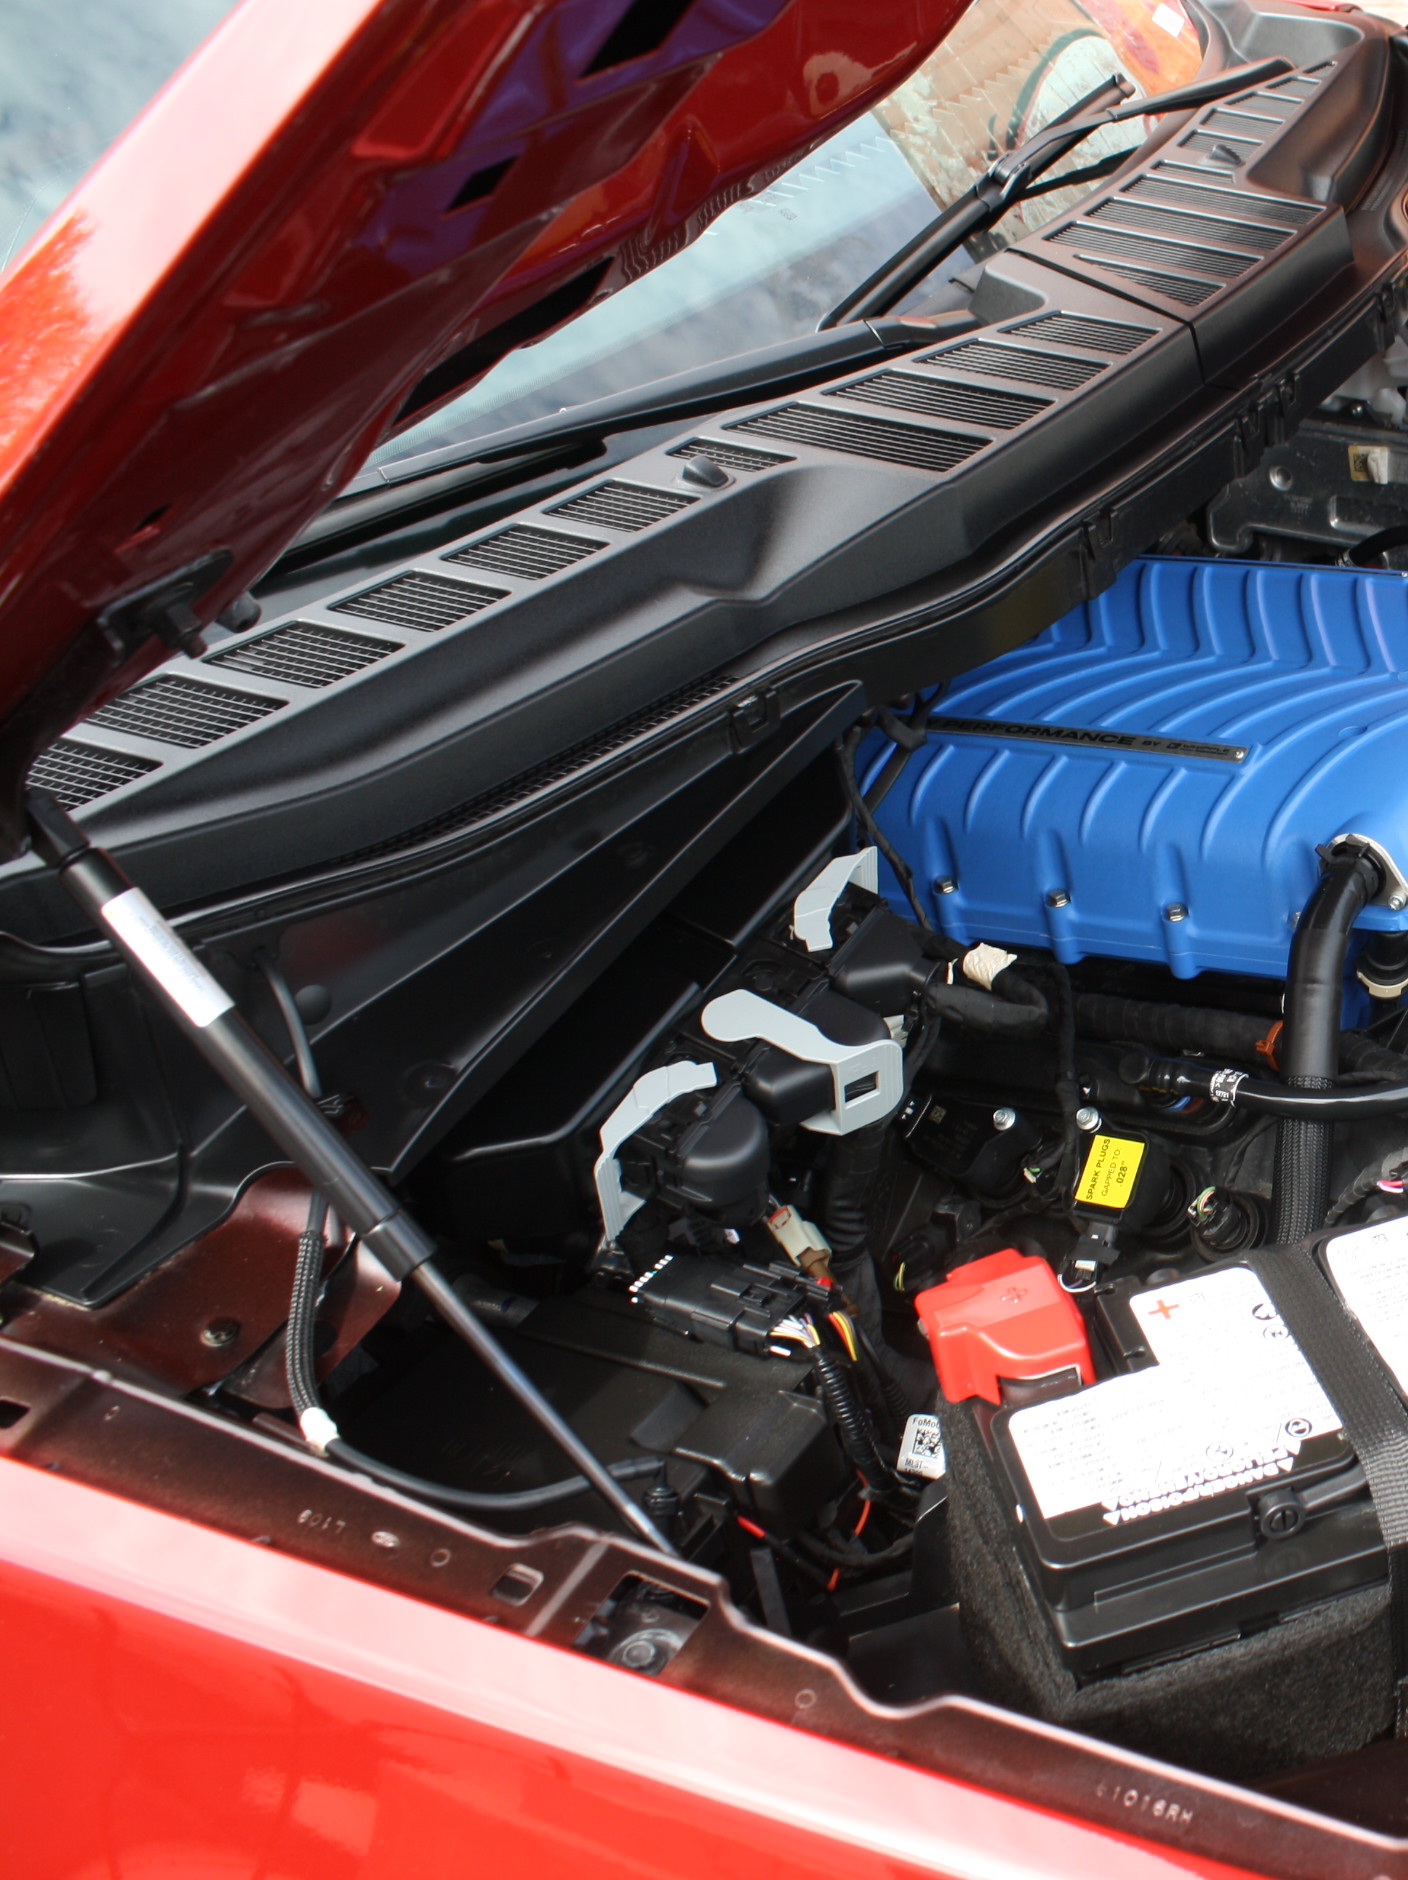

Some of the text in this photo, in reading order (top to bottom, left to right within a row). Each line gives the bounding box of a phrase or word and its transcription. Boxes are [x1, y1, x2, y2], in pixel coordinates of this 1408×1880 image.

[942, 719, 1136, 746] PERFORMANCE
[1142, 740, 1162, 748] BY
[1085, 1138, 1110, 1200] SPARK PLUGS
[1101, 1146, 1122, 1196] GAPPED TO:
[1119, 1461, 1279, 1521] DANGER/POISON
